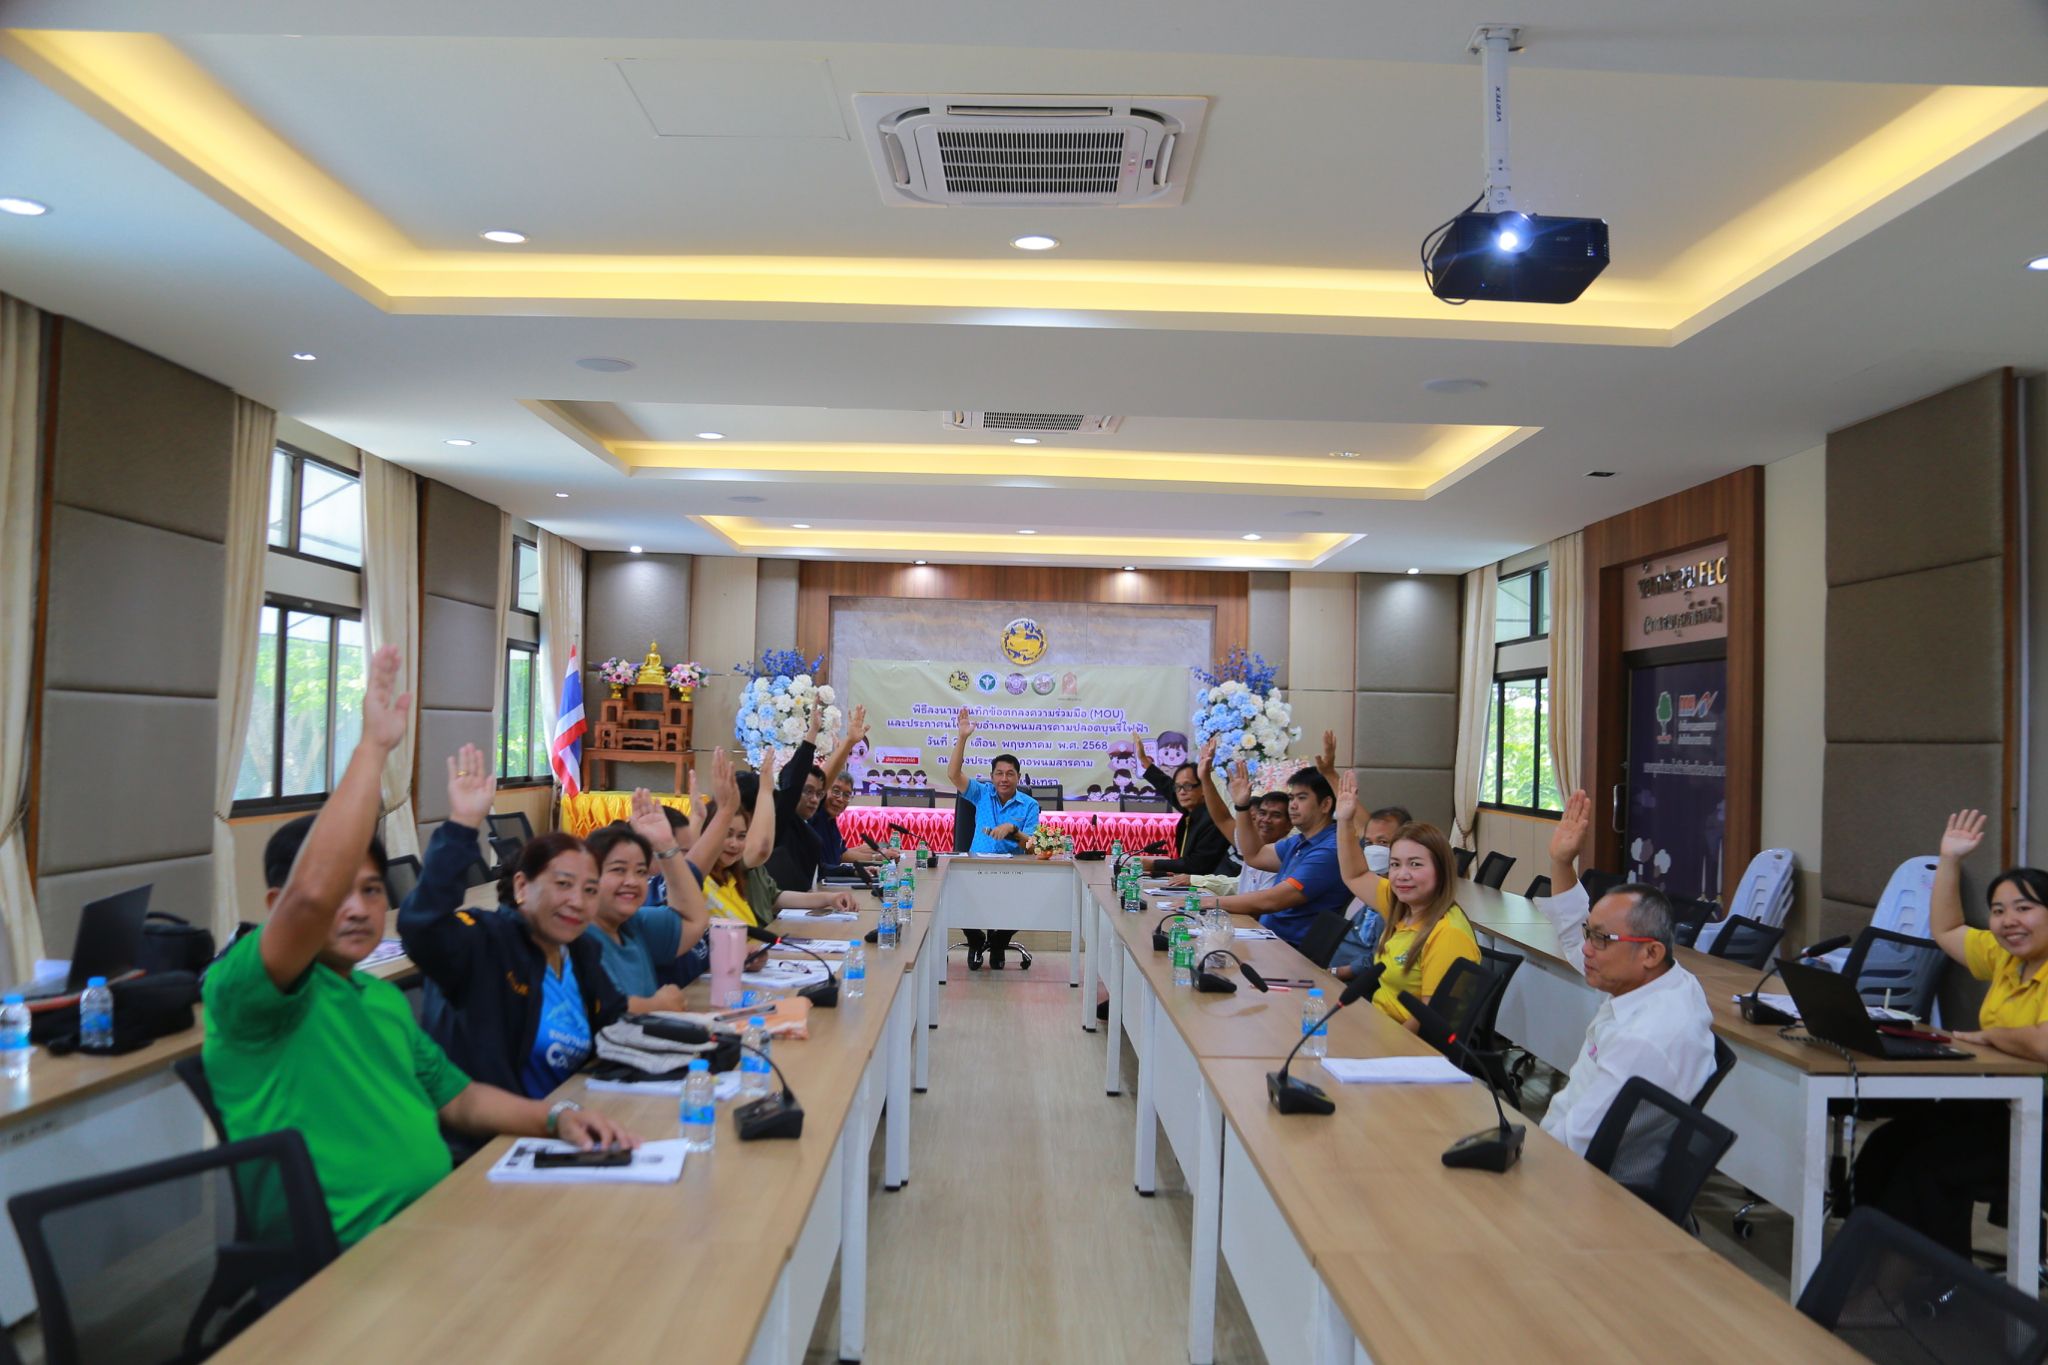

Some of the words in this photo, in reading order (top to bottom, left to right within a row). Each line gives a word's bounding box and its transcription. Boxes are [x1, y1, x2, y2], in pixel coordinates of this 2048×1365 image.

[1090, 708, 1124, 720] (MOU)
[927, 734, 948, 746] วันที่
[970, 736, 996, 747] เดือน
[1082, 740, 1108, 750] 2568
